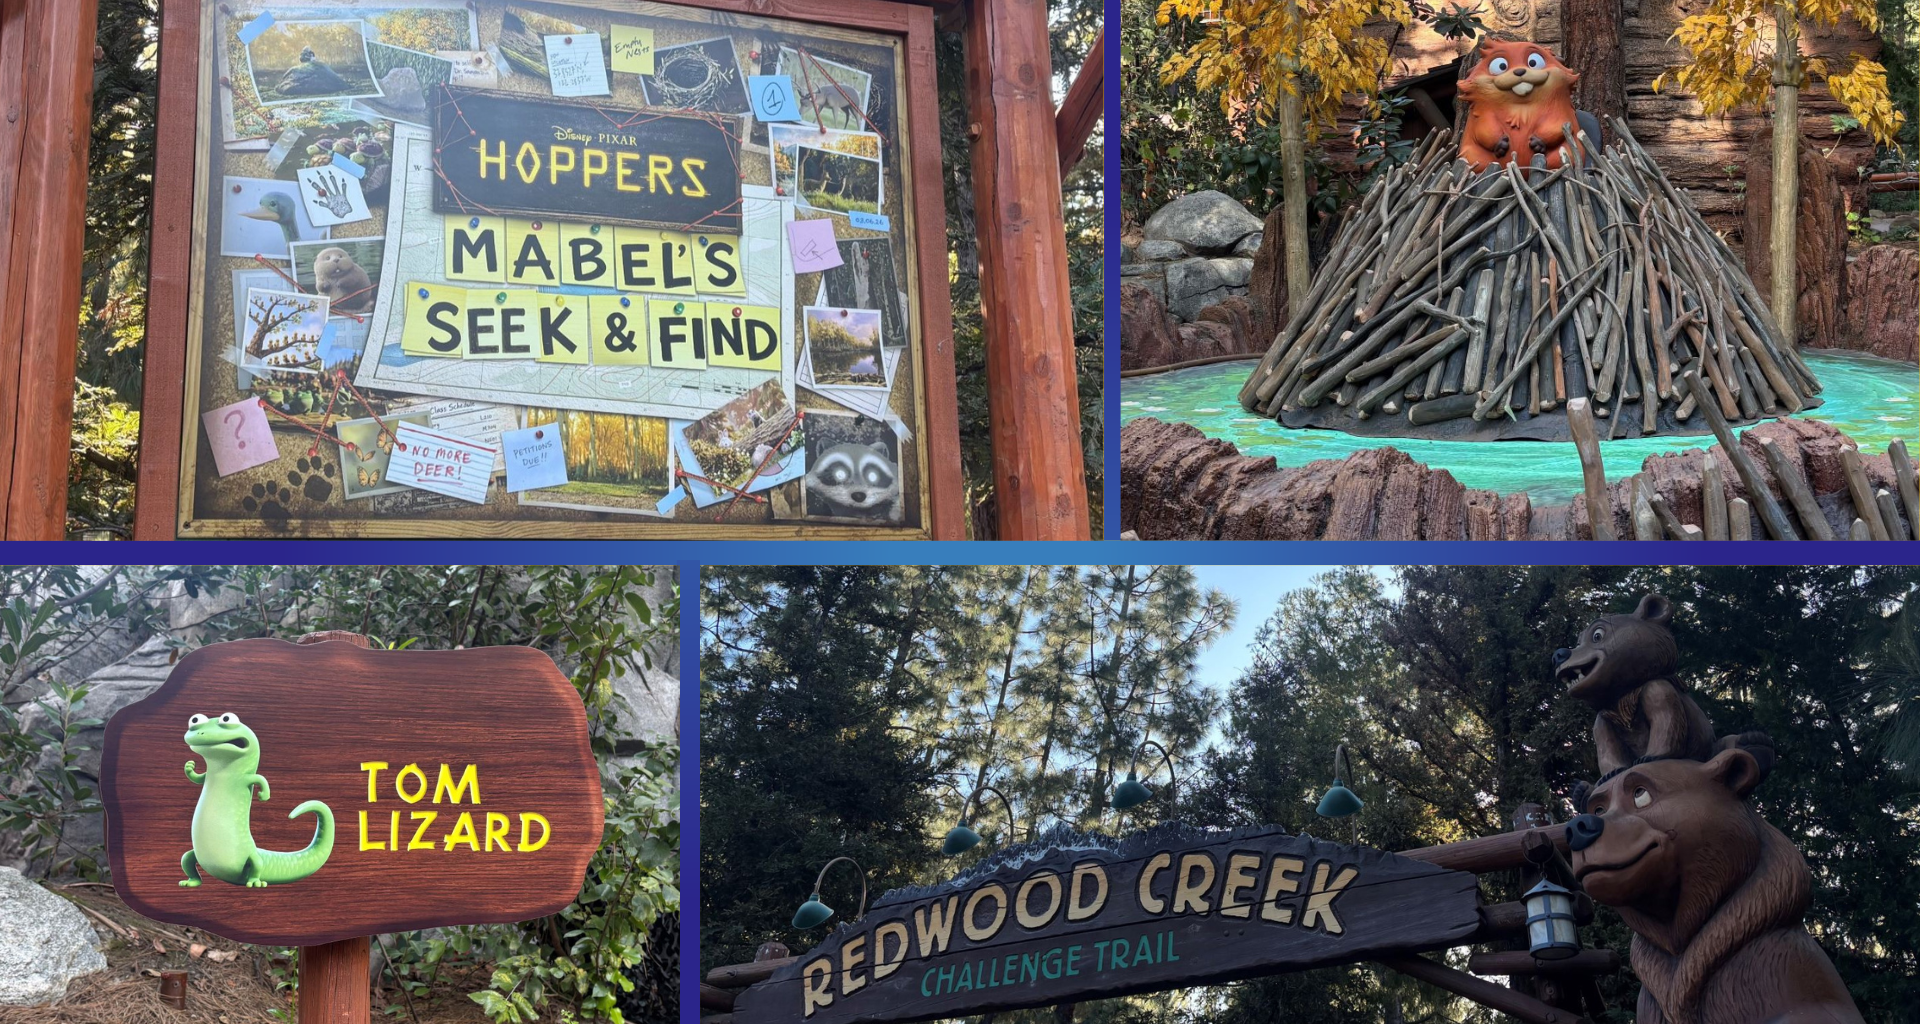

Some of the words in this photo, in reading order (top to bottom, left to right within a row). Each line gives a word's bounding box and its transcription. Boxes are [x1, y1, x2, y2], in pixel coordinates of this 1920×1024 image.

[614, 36, 642, 53] Empty
[626, 46, 650, 60] Nests
[767, 89, 781, 109] 1
[551, 125, 592, 146] Disney
[598, 133, 638, 147] PIXAR
[478, 138, 708, 198] HOPPERS
[452, 228, 738, 289] MABEL'S
[425, 301, 577, 355] SEEK
[604, 312, 637, 353] &
[659, 316, 778, 362] FIND
[430, 406, 450, 416] Class
[448, 401, 476, 411] Schedule
[412, 445, 430, 458] NO
[435, 447, 471, 464] MORE
[513, 440, 552, 459] PETITIONS
[414, 461, 462, 480] DEER!
[360, 761, 482, 805] TOM
[359, 810, 552, 853] LIZARD
[802, 862, 1109, 1018] REDWOOD
[1138, 851, 1359, 934] CREEK
[921, 945, 1082, 998] CHALLENGE
[1094, 930, 1180, 973] TRAIL
